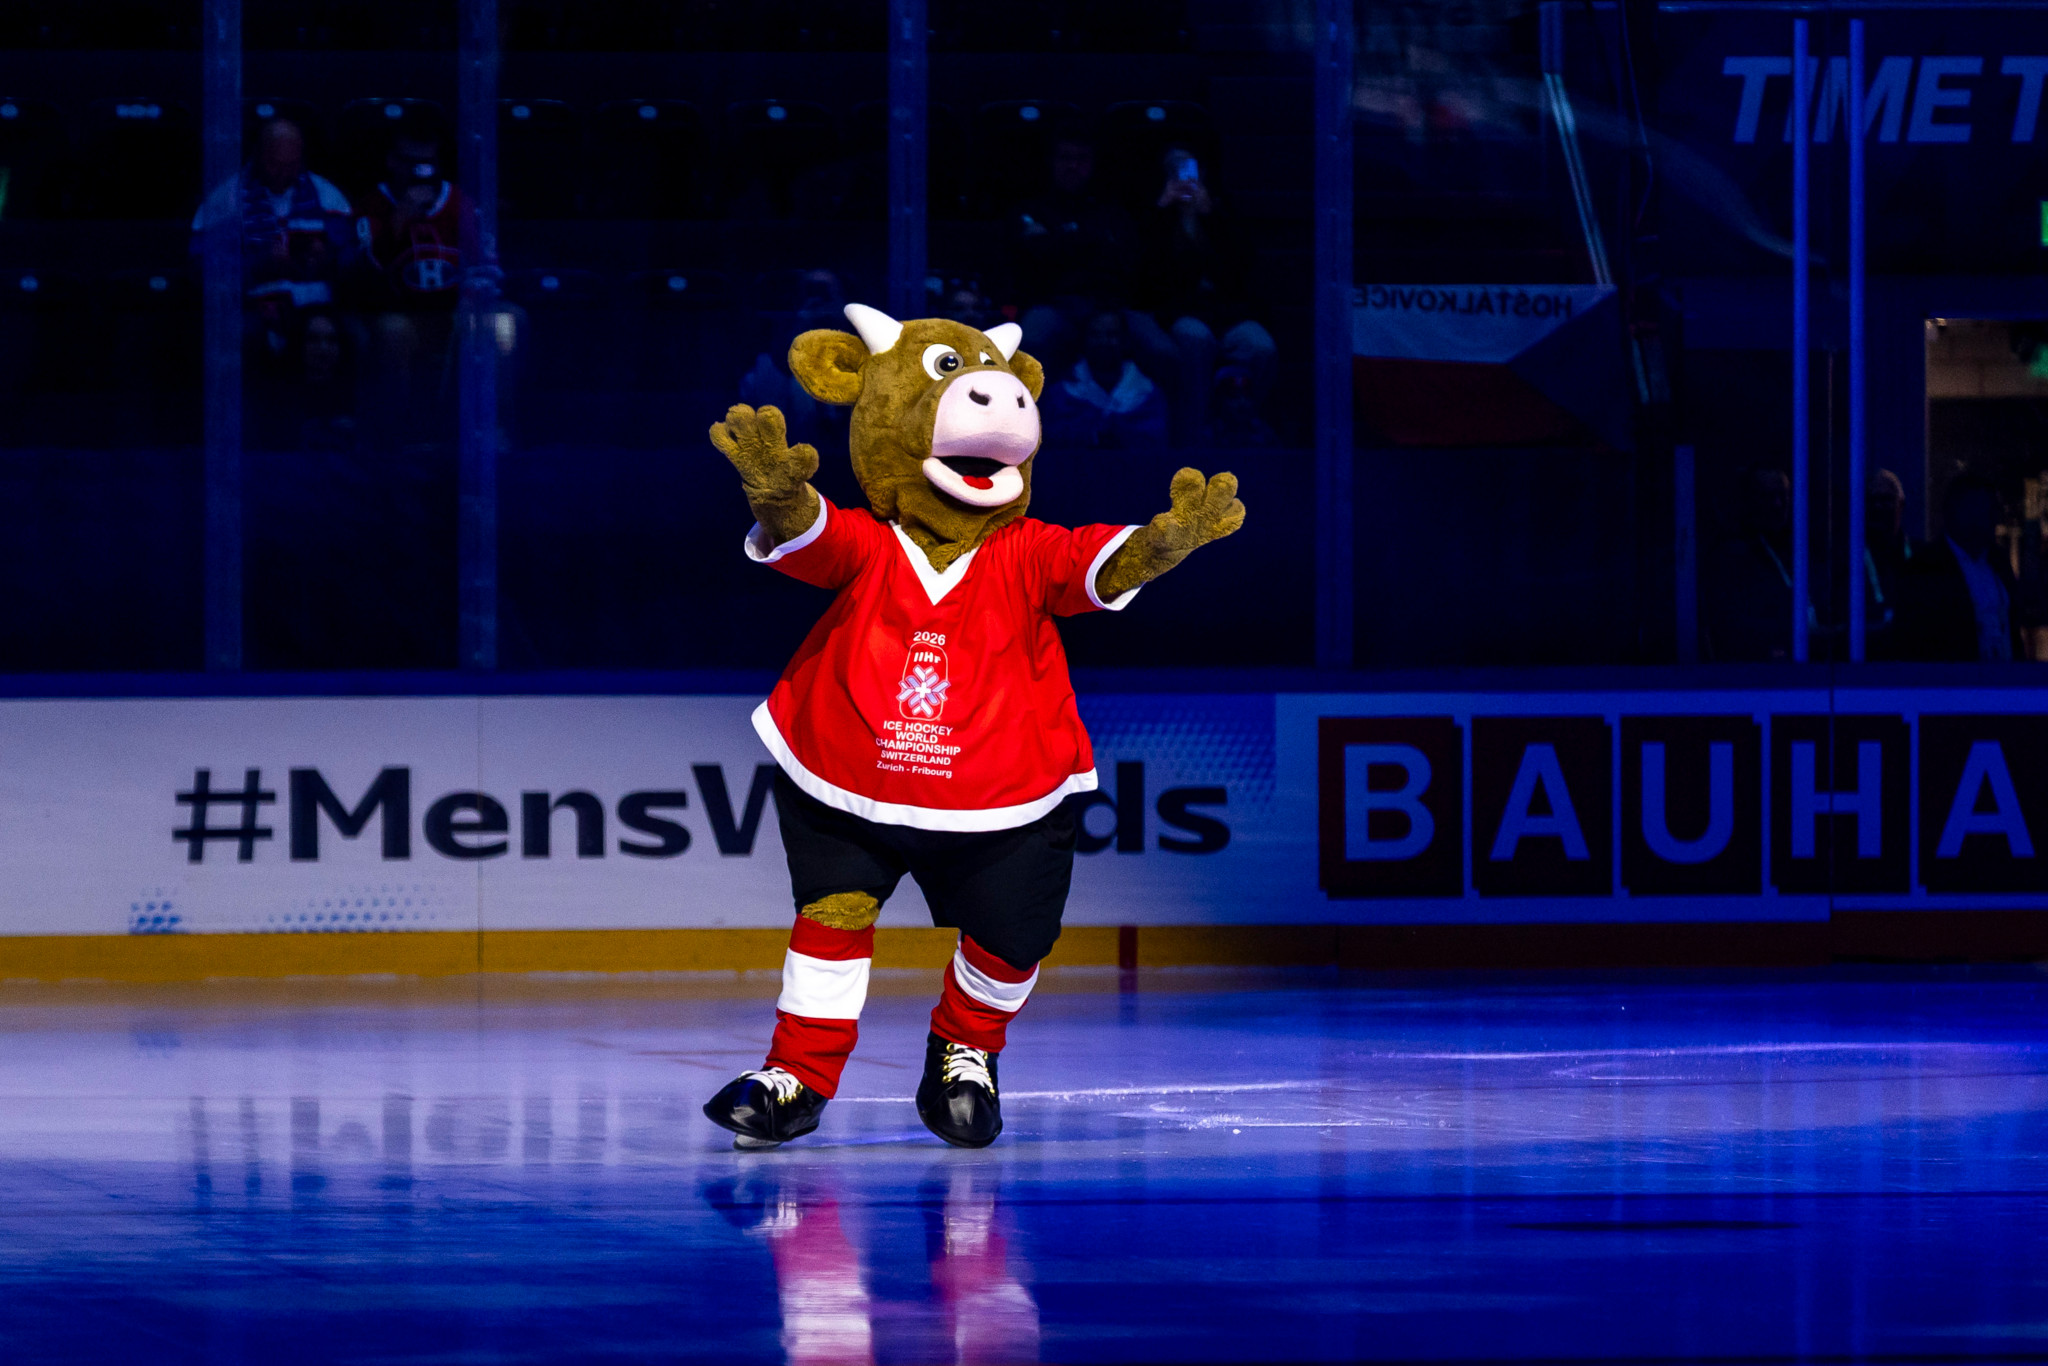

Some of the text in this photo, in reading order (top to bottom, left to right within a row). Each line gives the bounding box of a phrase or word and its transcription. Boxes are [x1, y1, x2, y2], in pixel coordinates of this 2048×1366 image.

[1722, 55, 1984, 144] TIME
[913, 631, 946, 646] 2026
[883, 720, 953, 737] ICE HOCKEY
[895, 731, 939, 744] WORLD
[875, 737, 961, 756] CHAMPIONSHIP
[880, 749, 952, 766] SWITZERLAND
[876, 760, 905, 772] Zurich
[912, 765, 953, 779] Fribourg
[1344, 741, 2036, 864] BAUHA
[172, 762, 1232, 863] #MensWds
